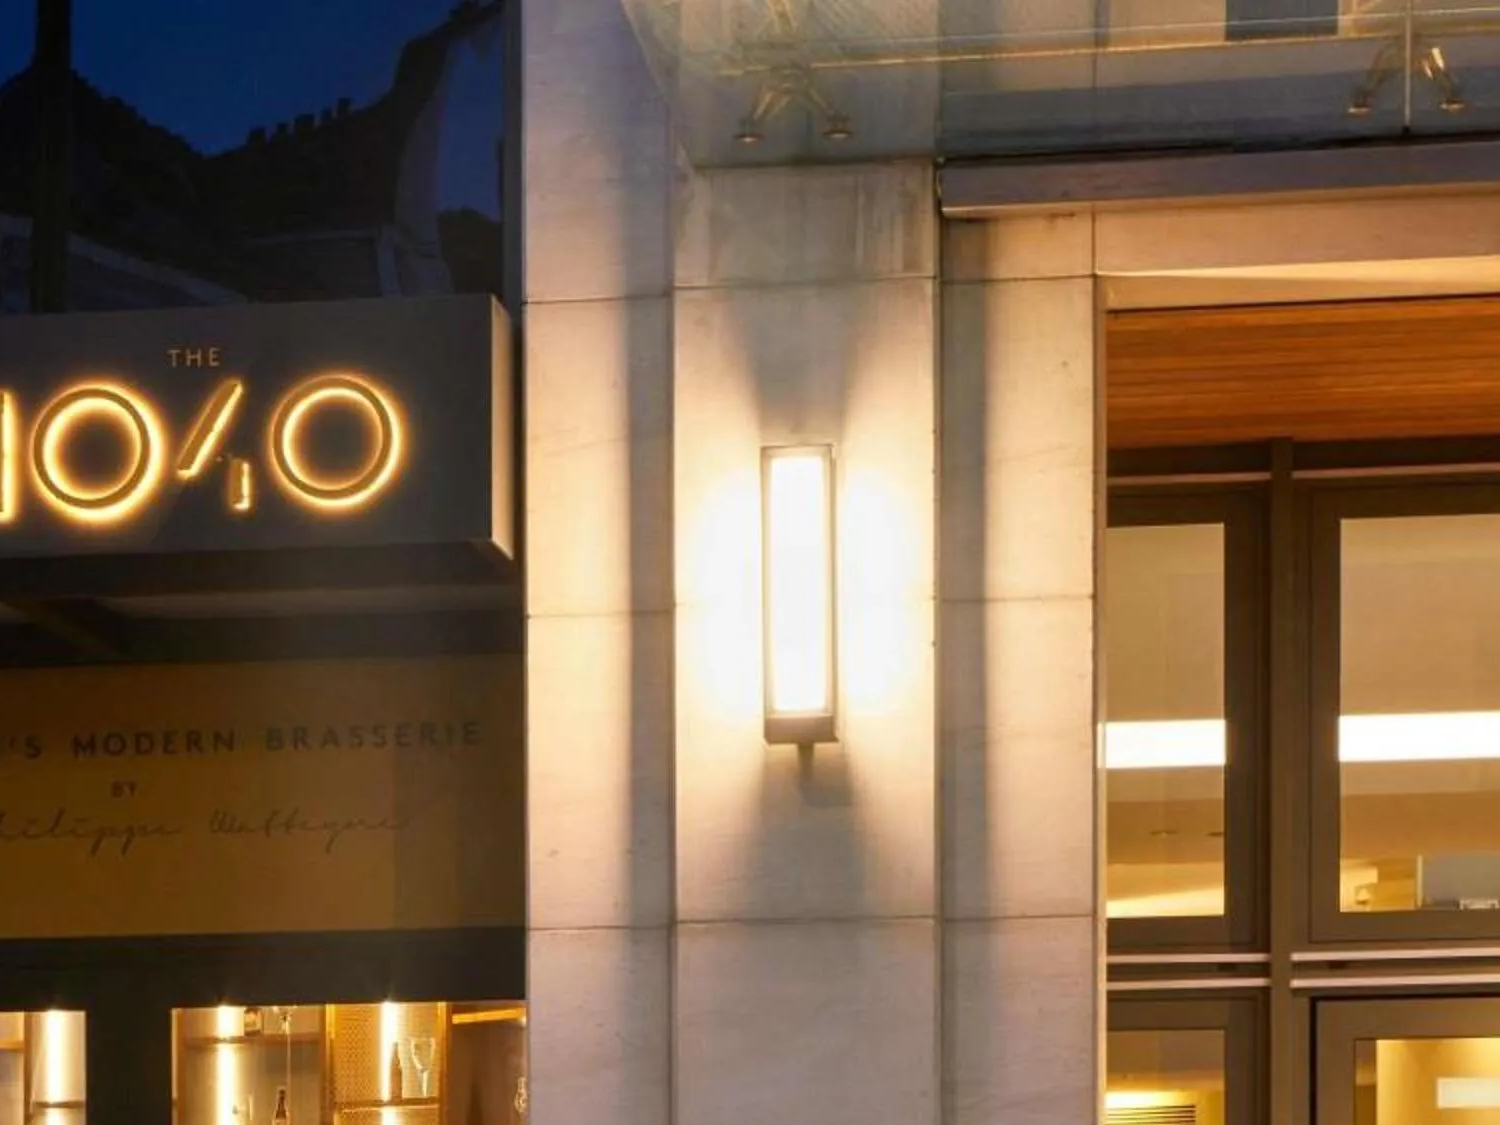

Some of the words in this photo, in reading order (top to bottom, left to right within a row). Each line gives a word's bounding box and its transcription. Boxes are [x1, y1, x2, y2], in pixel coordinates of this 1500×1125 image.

[166, 347, 221, 368] THE
[71, 728, 236, 758] MODERN
[265, 720, 482, 751] BRASSERIE
[110, 780, 137, 799] BY
